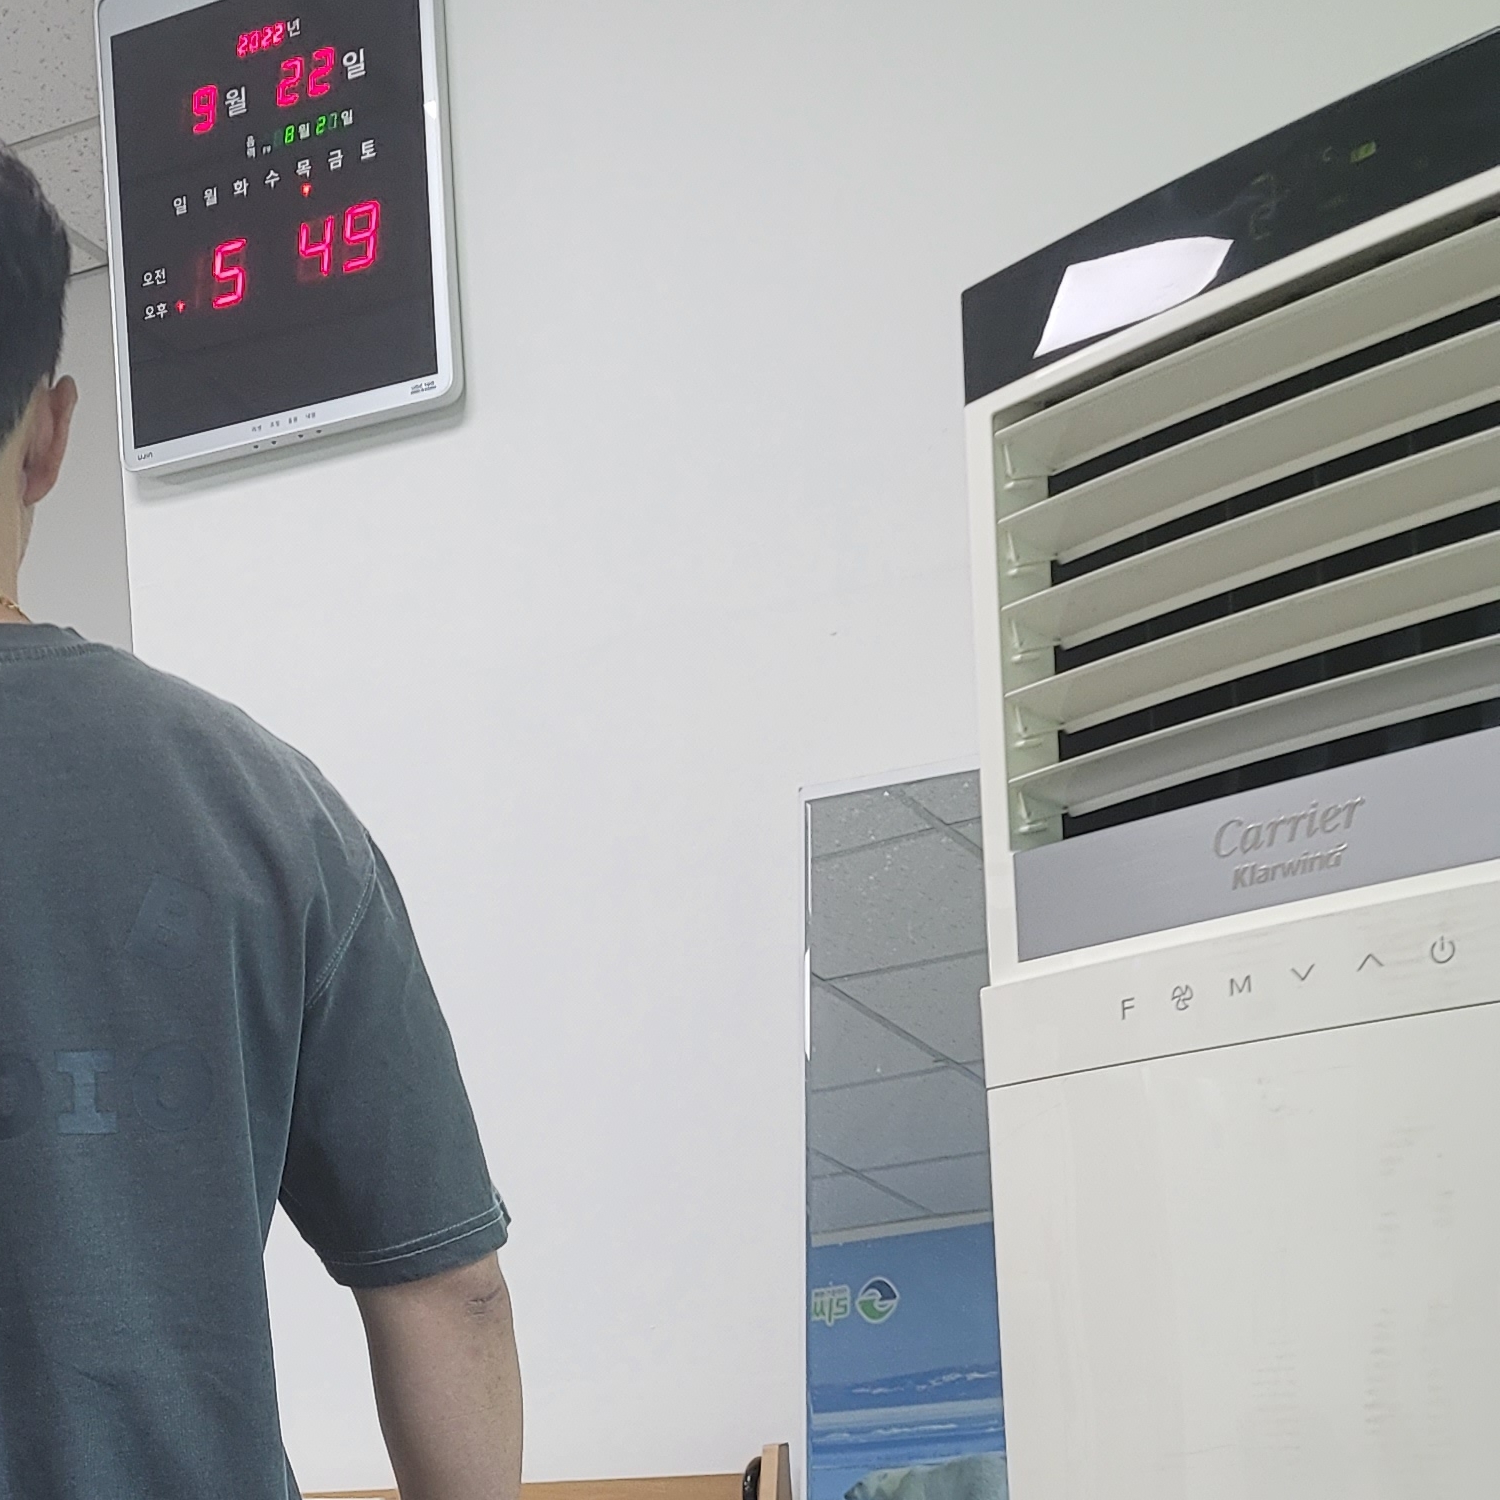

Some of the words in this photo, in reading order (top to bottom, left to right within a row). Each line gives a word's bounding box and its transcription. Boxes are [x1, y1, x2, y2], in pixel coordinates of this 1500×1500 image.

[237, 17, 300, 57] 2022년
[173, 195, 188, 216] 일
[204, 186, 218, 207] 월
[233, 177, 249, 197] 화
[264, 169, 280, 189] 수
[296, 159, 311, 178] 목
[328, 149, 343, 171] 금
[361, 139, 376, 162] 토
[142, 268, 166, 287] 오전
[212, 238, 247, 309] 5
[297, 200, 381, 276] 49
[144, 302, 168, 321] 오후
[1213, 796, 1366, 859] Carrier
[1120, 997, 1136, 1021] F
[1228, 974, 1253, 997] M
